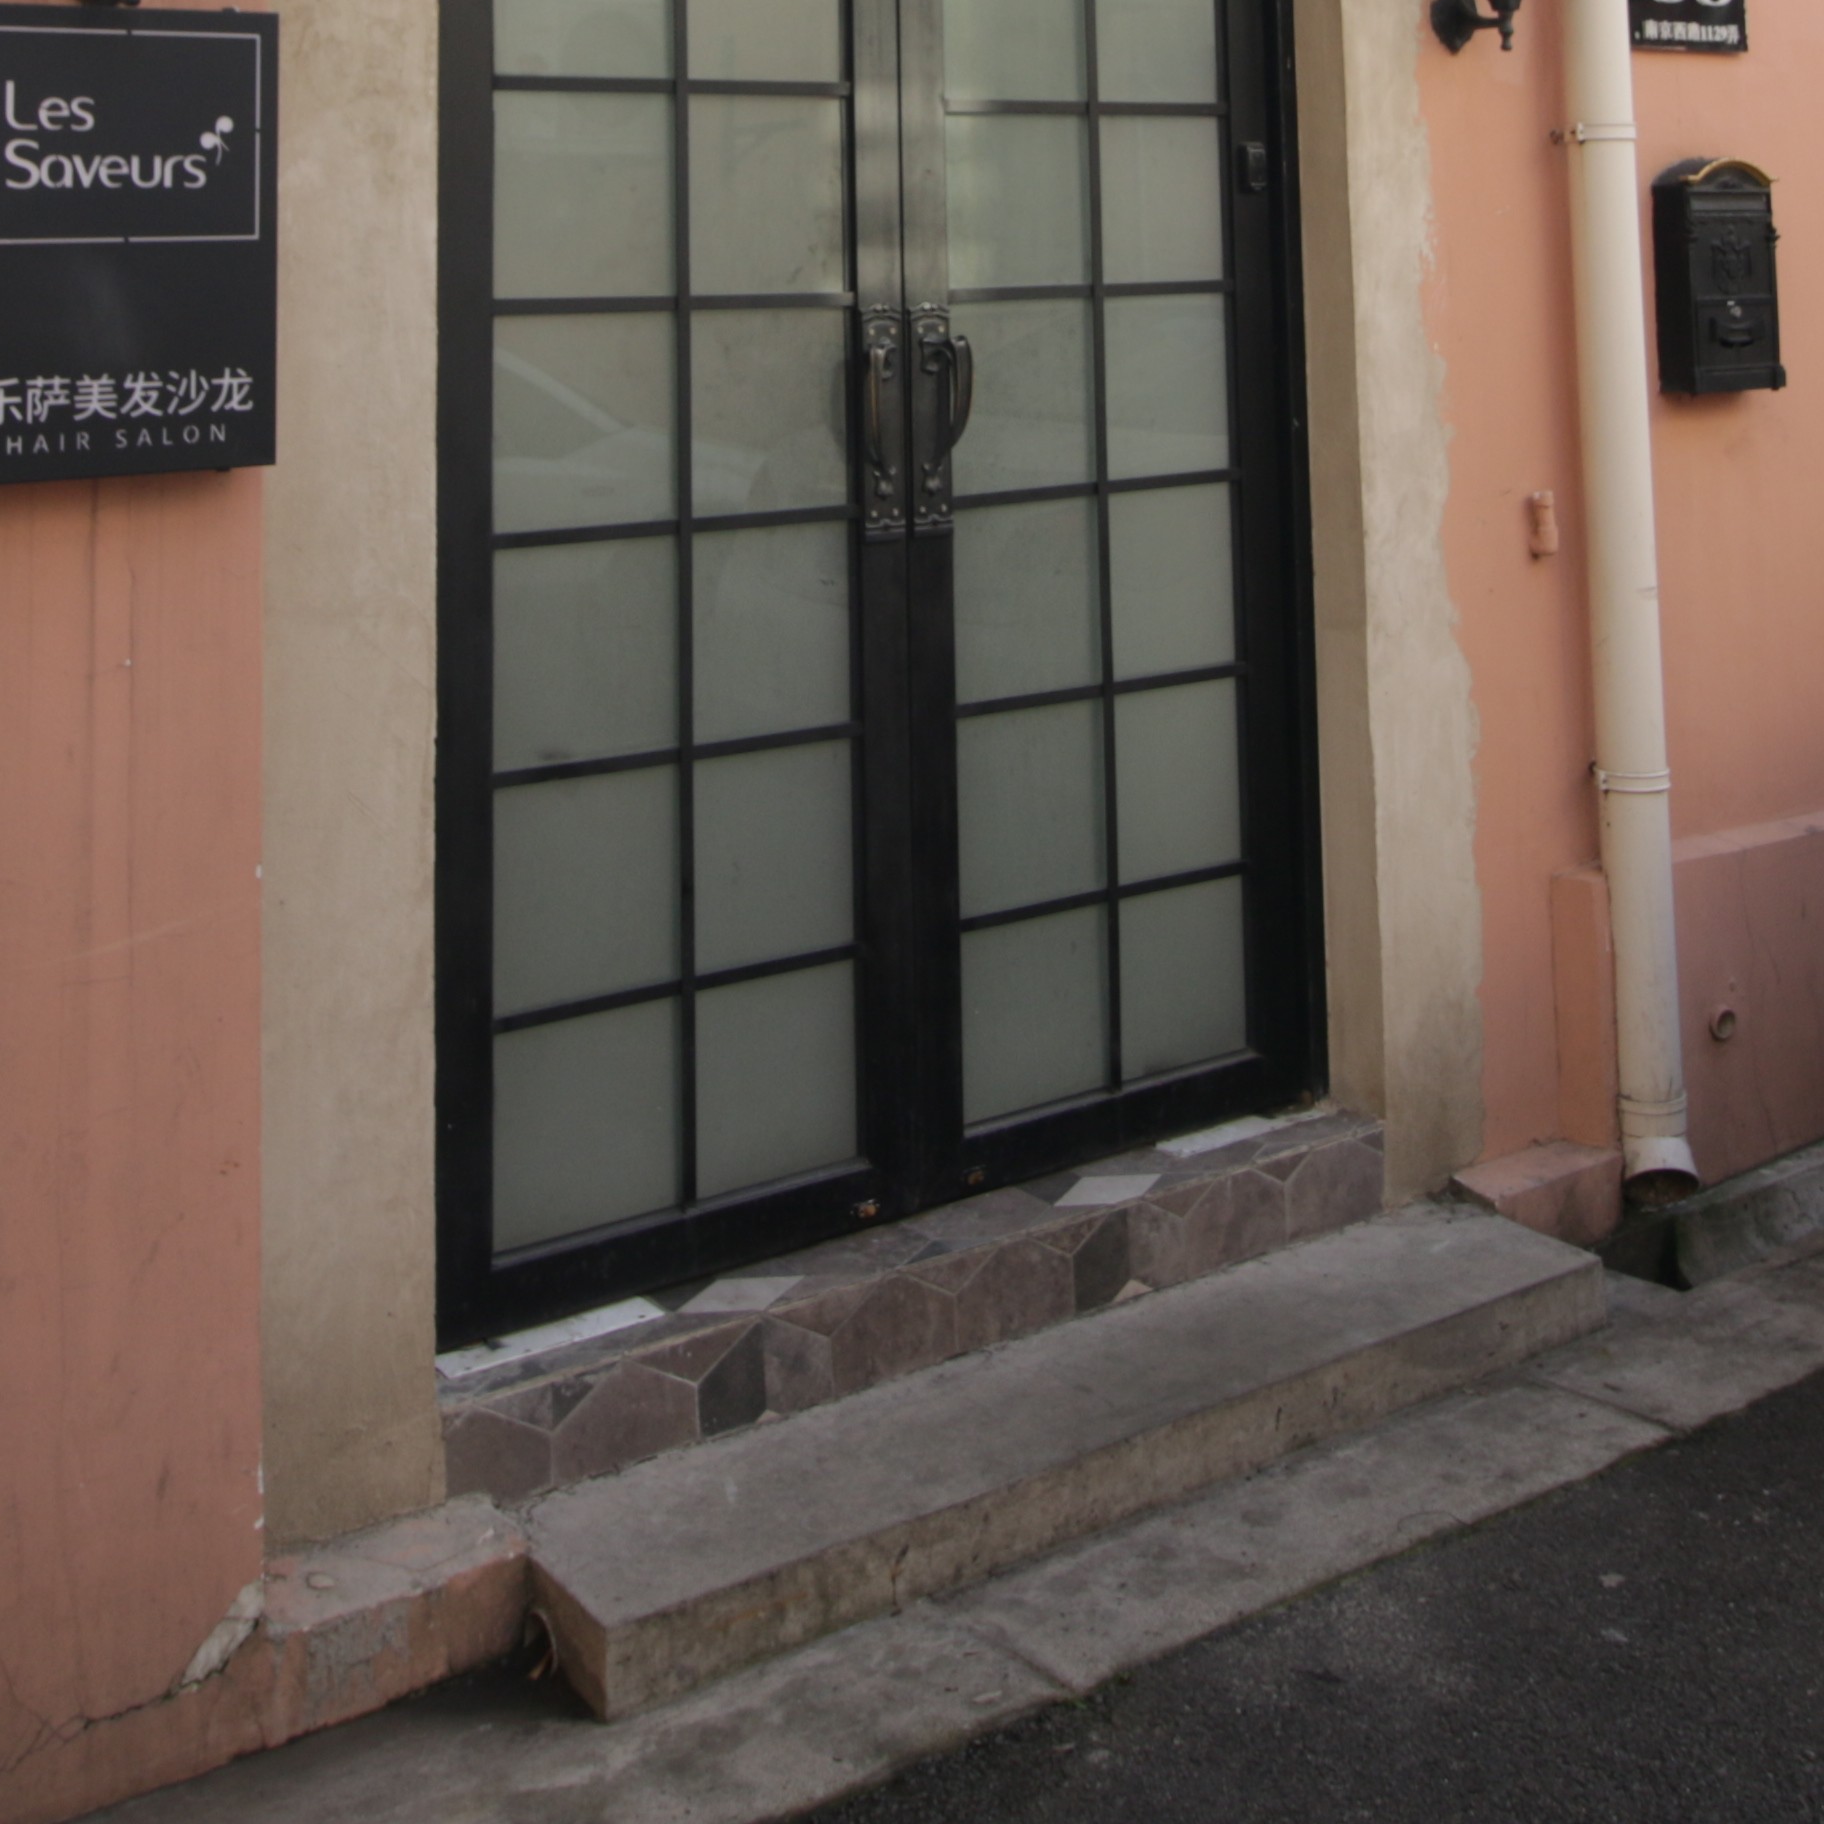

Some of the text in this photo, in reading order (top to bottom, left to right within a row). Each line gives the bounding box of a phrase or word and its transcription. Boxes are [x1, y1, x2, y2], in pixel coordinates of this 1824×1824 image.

[5, 80, 95, 131] Les
[4, 138, 207, 190] Saveurs
[6, 423, 227, 455] HAIR SALON
